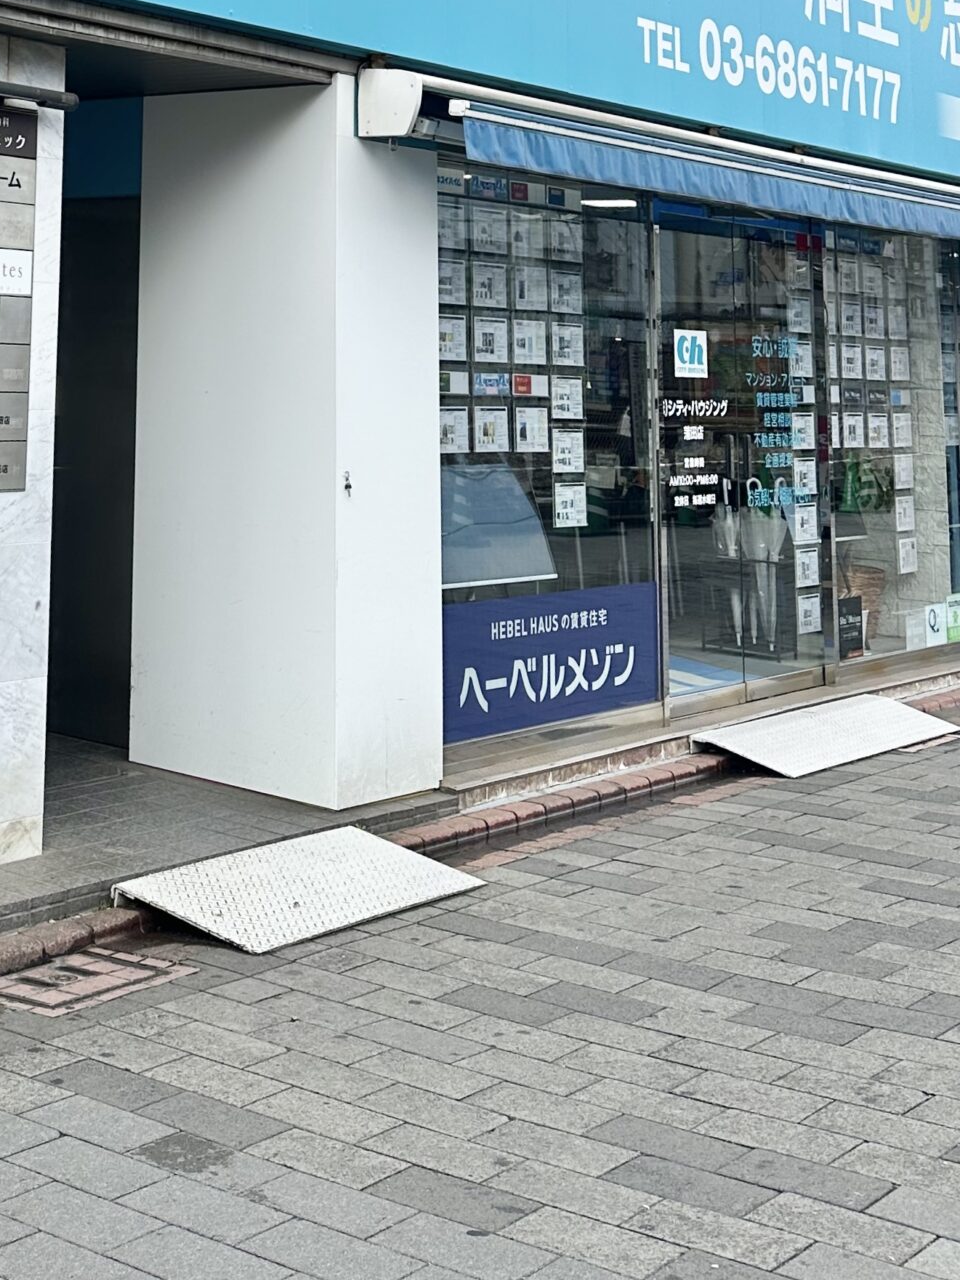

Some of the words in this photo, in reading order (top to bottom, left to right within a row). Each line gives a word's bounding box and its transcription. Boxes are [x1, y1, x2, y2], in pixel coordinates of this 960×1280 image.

[637, 17, 690, 74] TEL
[699, 18, 902, 125] 03-6861-7177
[491, 619, 528, 641] HEBEL
[530, 614, 559, 636] HAUS
[561, 608, 608, 630] の賃貸住宅
[460, 643, 635, 713] ヘーベルメゾン
